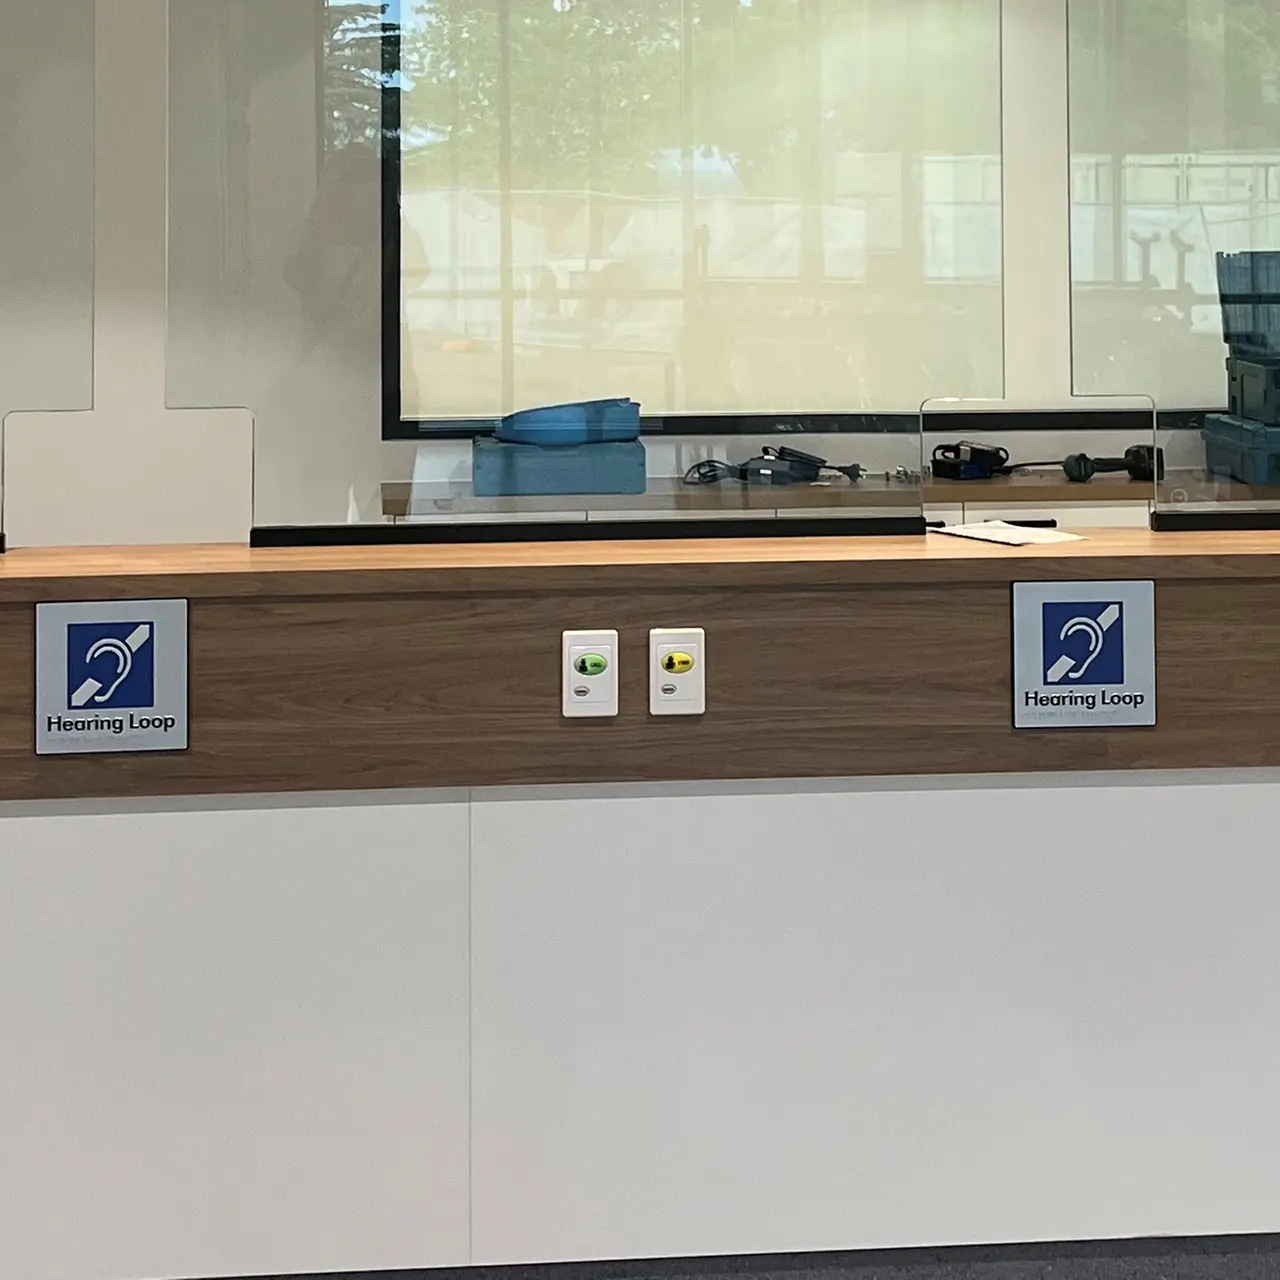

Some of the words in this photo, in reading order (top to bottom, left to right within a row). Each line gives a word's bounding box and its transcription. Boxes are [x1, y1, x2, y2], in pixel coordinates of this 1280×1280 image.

[1024, 690, 1096, 710] Hearing
[1102, 690, 1145, 709] Loop
[47, 714, 123, 734] Hearing
[129, 713, 176, 732] Loop
